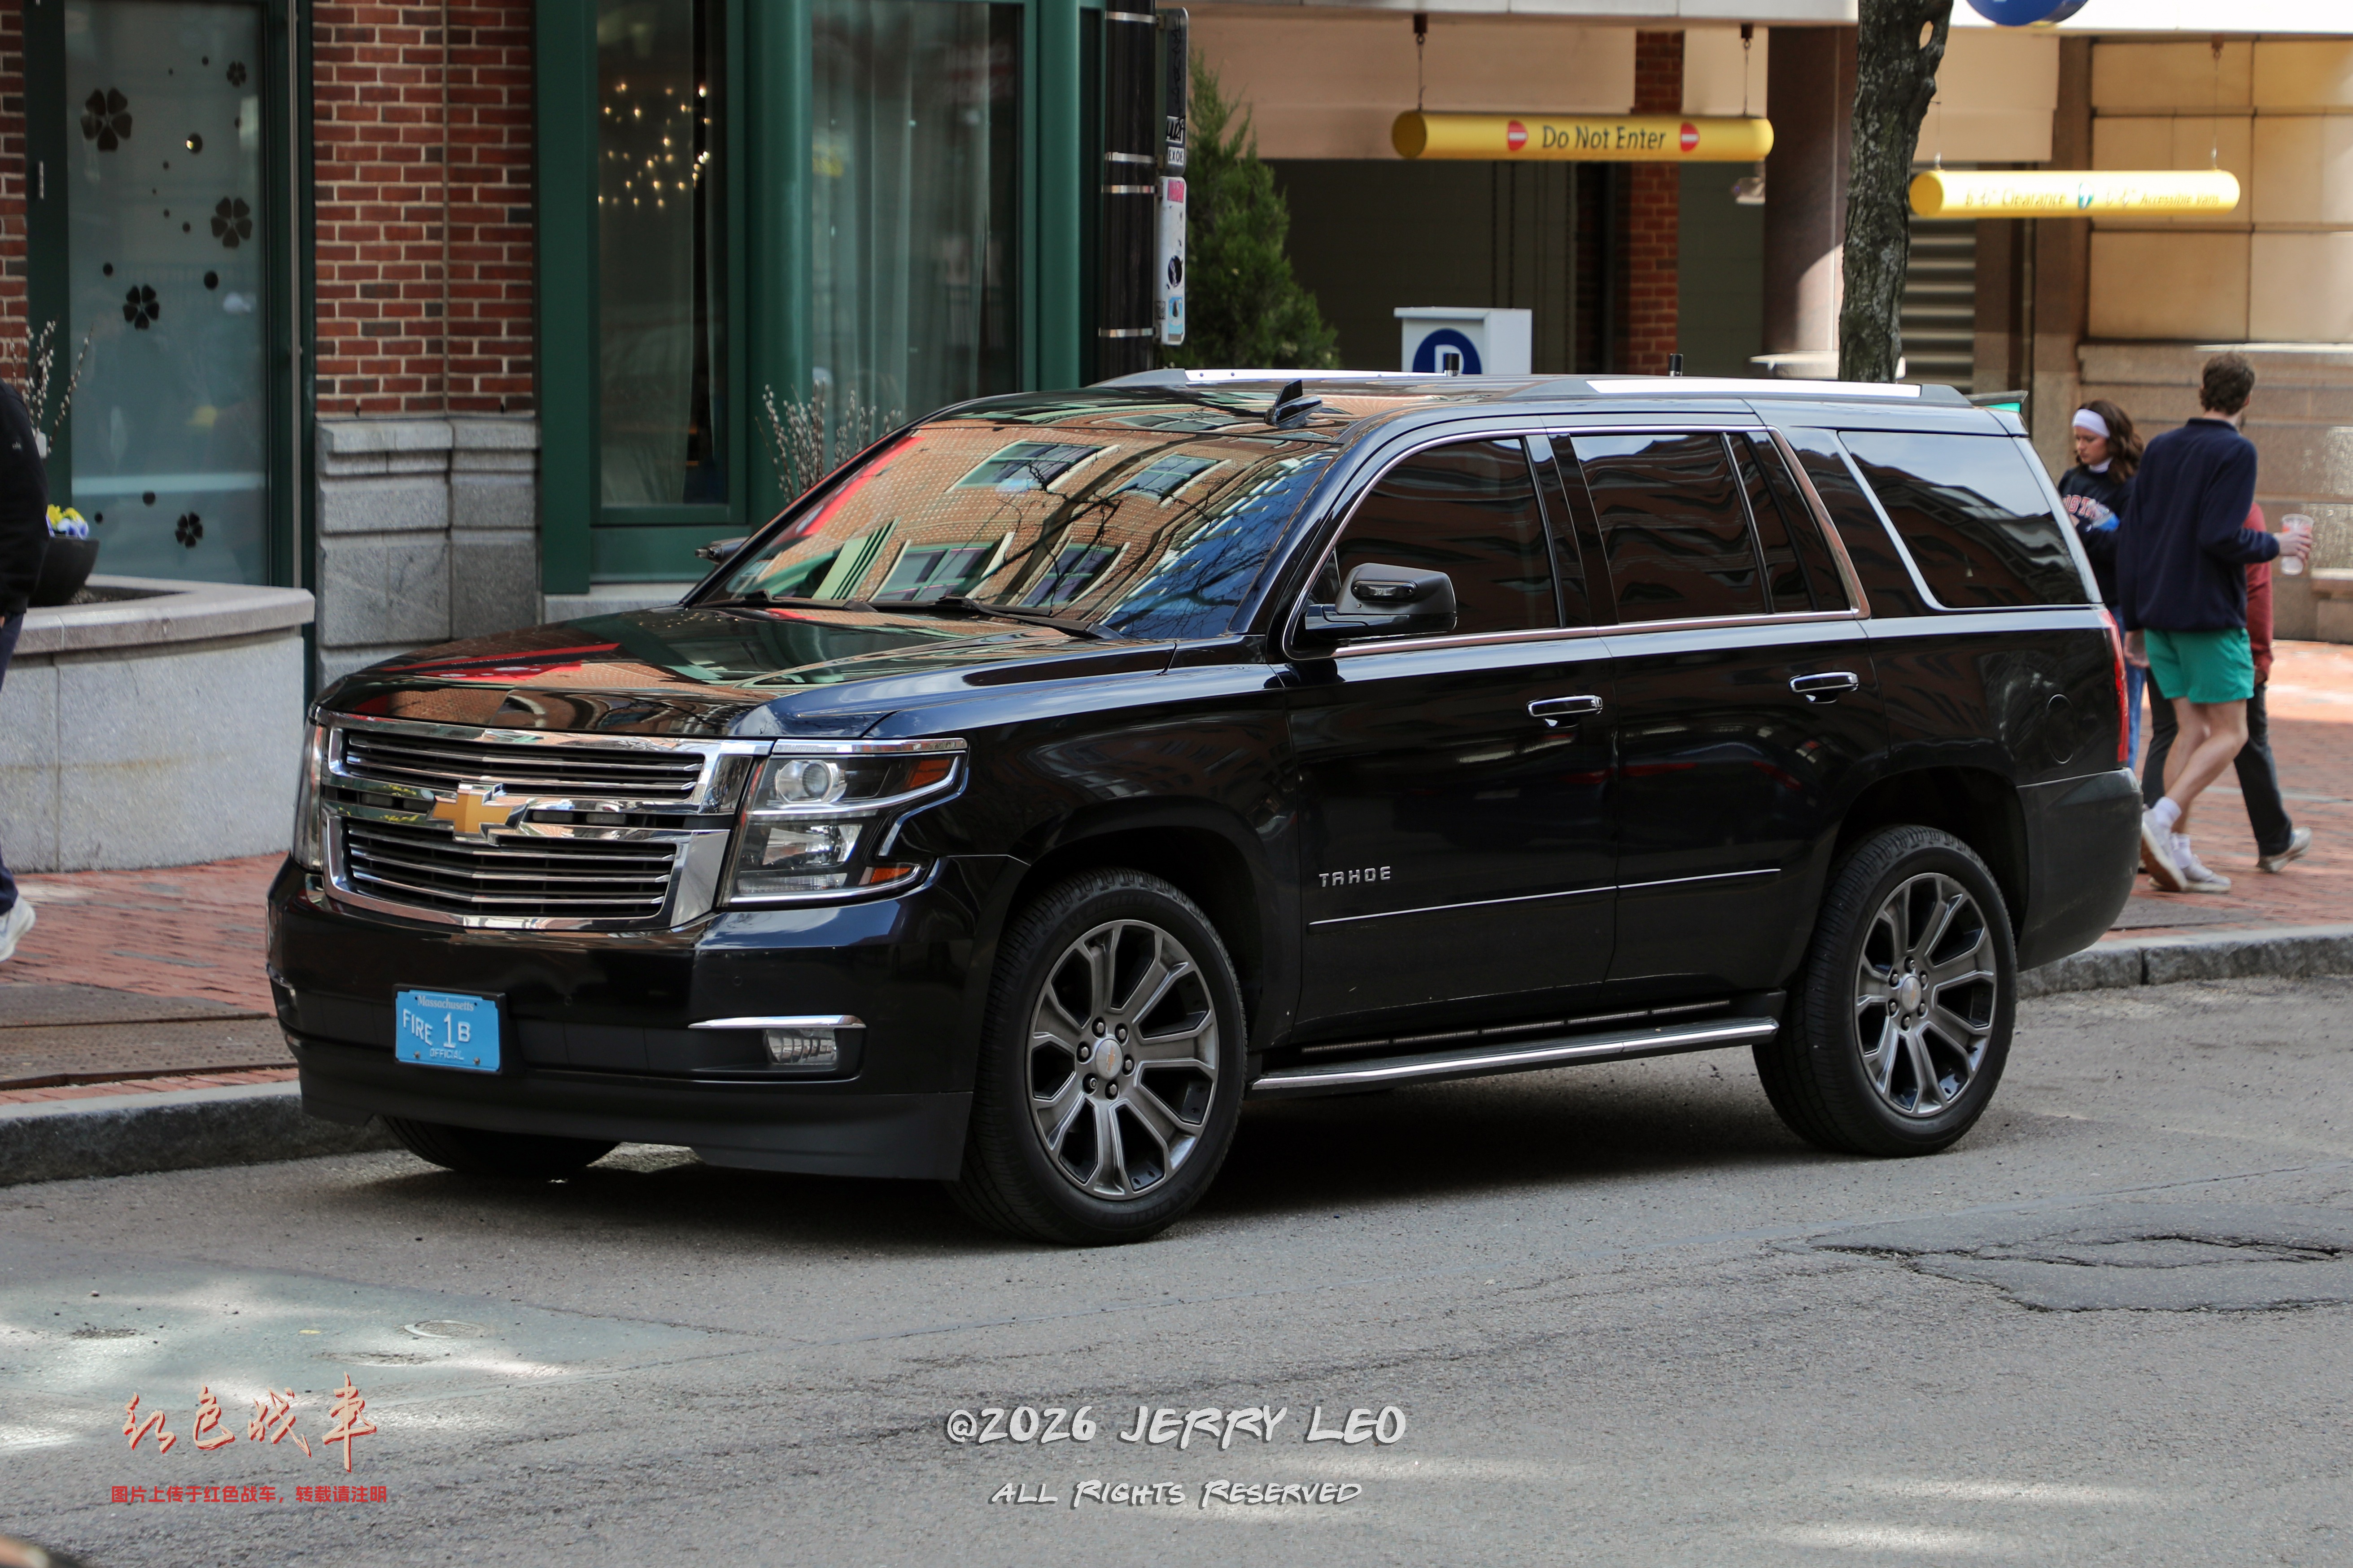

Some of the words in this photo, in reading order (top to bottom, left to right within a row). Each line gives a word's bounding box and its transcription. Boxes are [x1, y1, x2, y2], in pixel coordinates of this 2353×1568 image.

[1542, 125, 1569, 148] Do
[1575, 125, 1611, 149] Not
[1616, 126, 1667, 149] Enter
[1318, 866, 1391, 887] TAHOE
[417, 994, 474, 1011] Massachusetts
[403, 1008, 433, 1046] FIRE
[429, 1048, 464, 1060] OFFICIAL
